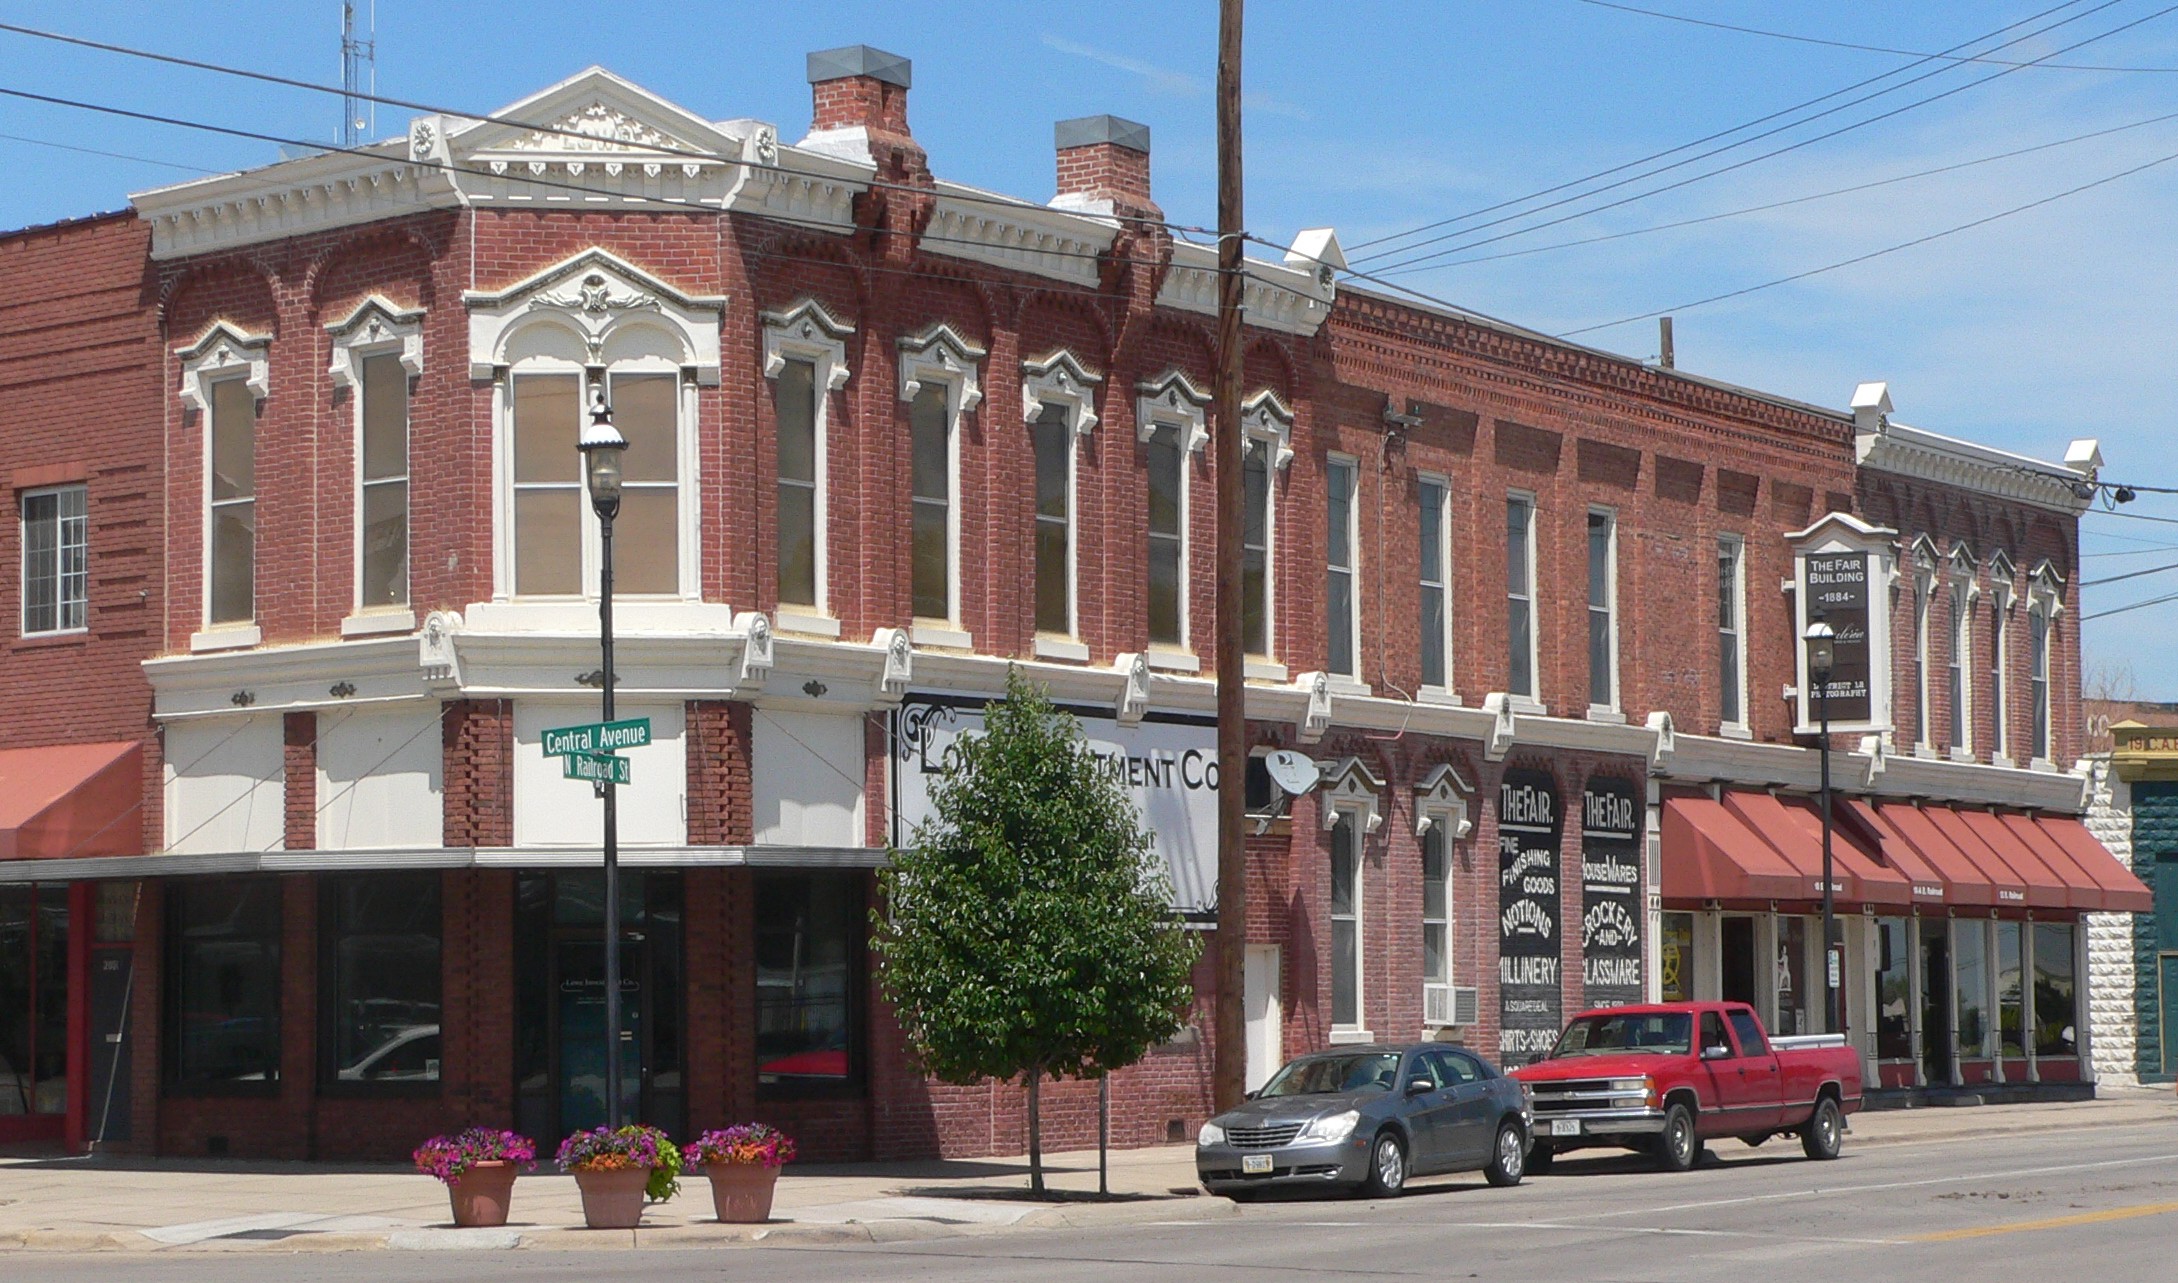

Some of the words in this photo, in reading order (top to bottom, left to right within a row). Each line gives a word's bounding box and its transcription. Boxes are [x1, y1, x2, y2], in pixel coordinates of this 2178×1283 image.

[1811, 560, 1833, 571] THE
[1835, 559, 1861, 570] FAIR
[1810, 572, 1864, 584] BUILDING
[1811, 681, 1851, 690] DTRICT
[1811, 690, 1867, 699] PHTOGRAPHY
[546, 729, 592, 754] Central
[600, 725, 645, 748] Avenue
[564, 754, 572, 774] N
[576, 757, 613, 780] Railroad
[619, 761, 629, 781] St
[1502, 849, 1551, 887] FINISHING
[1523, 876, 1555, 895] GOODS
[1502, 899, 1552, 939] NOTIONS
